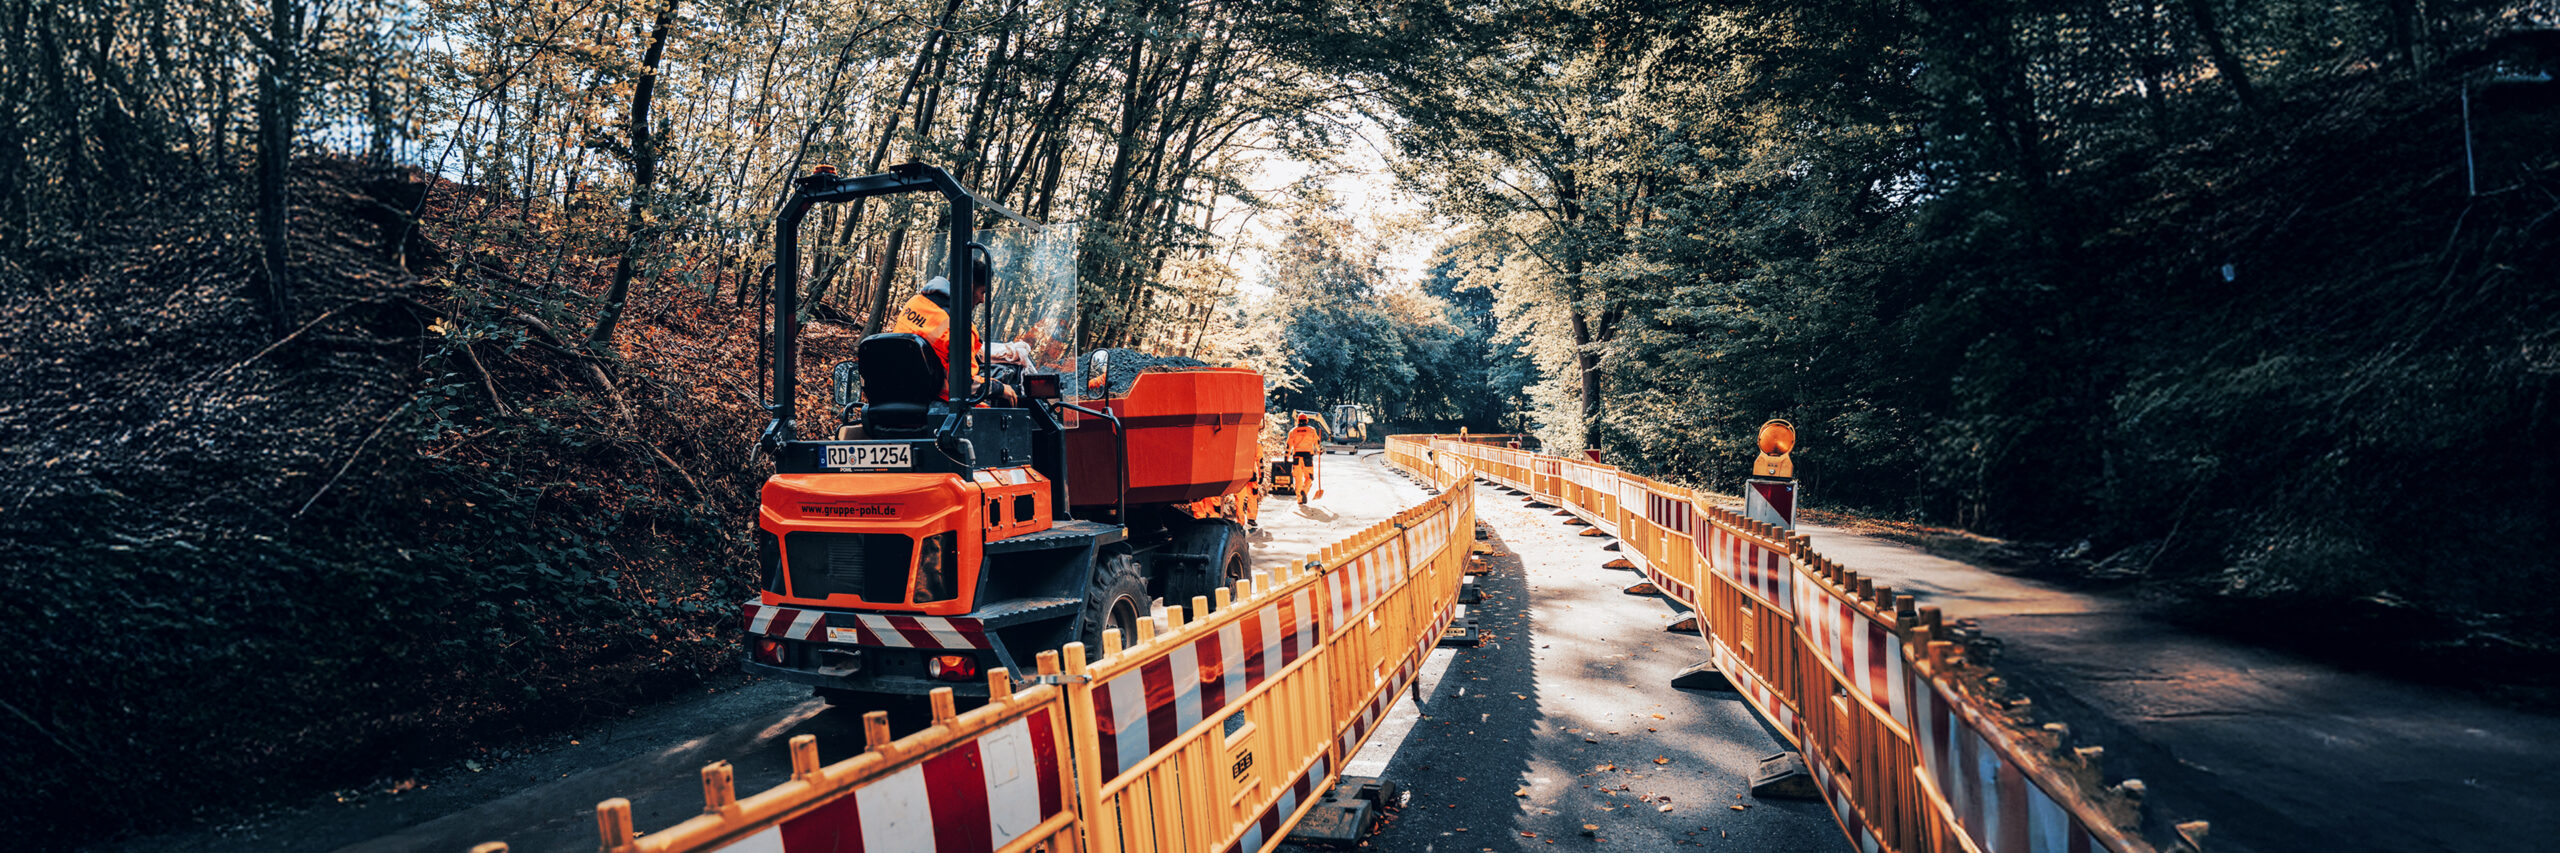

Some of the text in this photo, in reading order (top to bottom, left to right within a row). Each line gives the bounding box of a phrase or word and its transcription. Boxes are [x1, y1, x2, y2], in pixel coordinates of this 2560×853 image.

[903, 307, 927, 328] POHL
[828, 446, 909, 465] RD P 1254
[801, 505, 896, 517] www.gruppe-pohl.de
